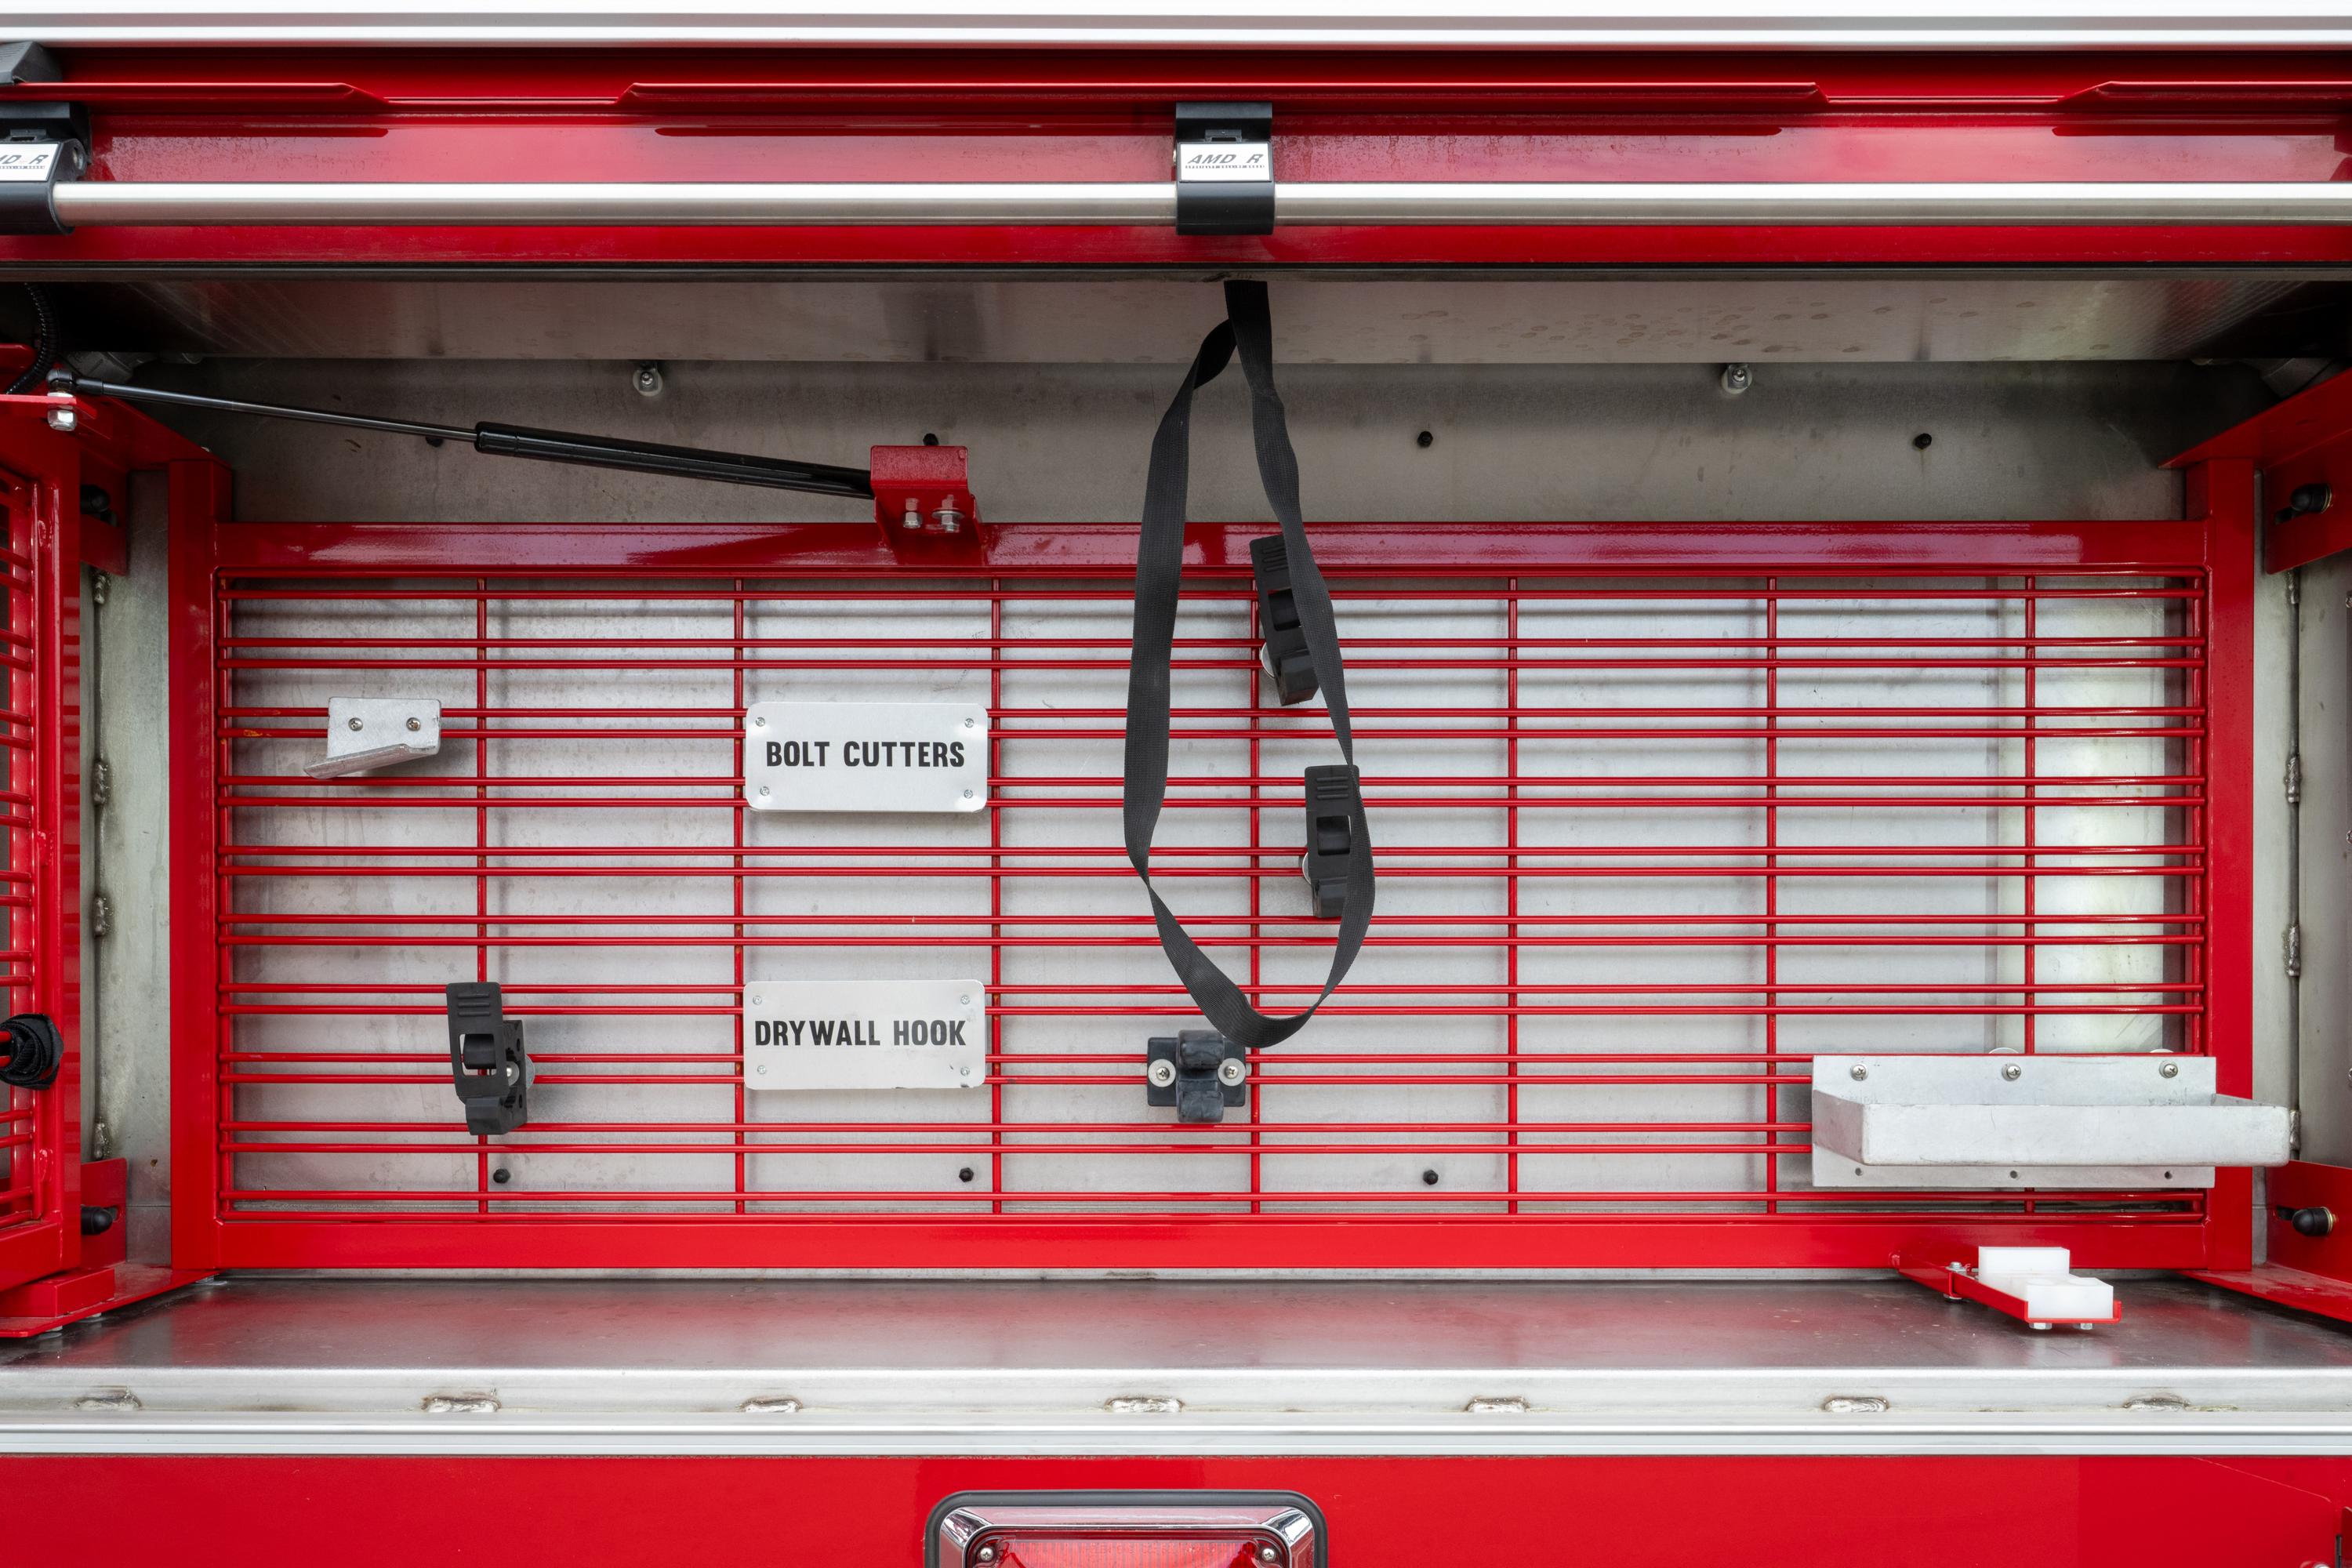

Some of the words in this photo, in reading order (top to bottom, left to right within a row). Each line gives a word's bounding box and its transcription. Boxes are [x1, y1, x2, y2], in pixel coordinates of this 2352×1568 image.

[766, 741, 830, 767] BOLT
[844, 741, 965, 768] CUTTERS
[755, 1020, 880, 1046] DRYWALL
[894, 1020, 966, 1046] HOOK
